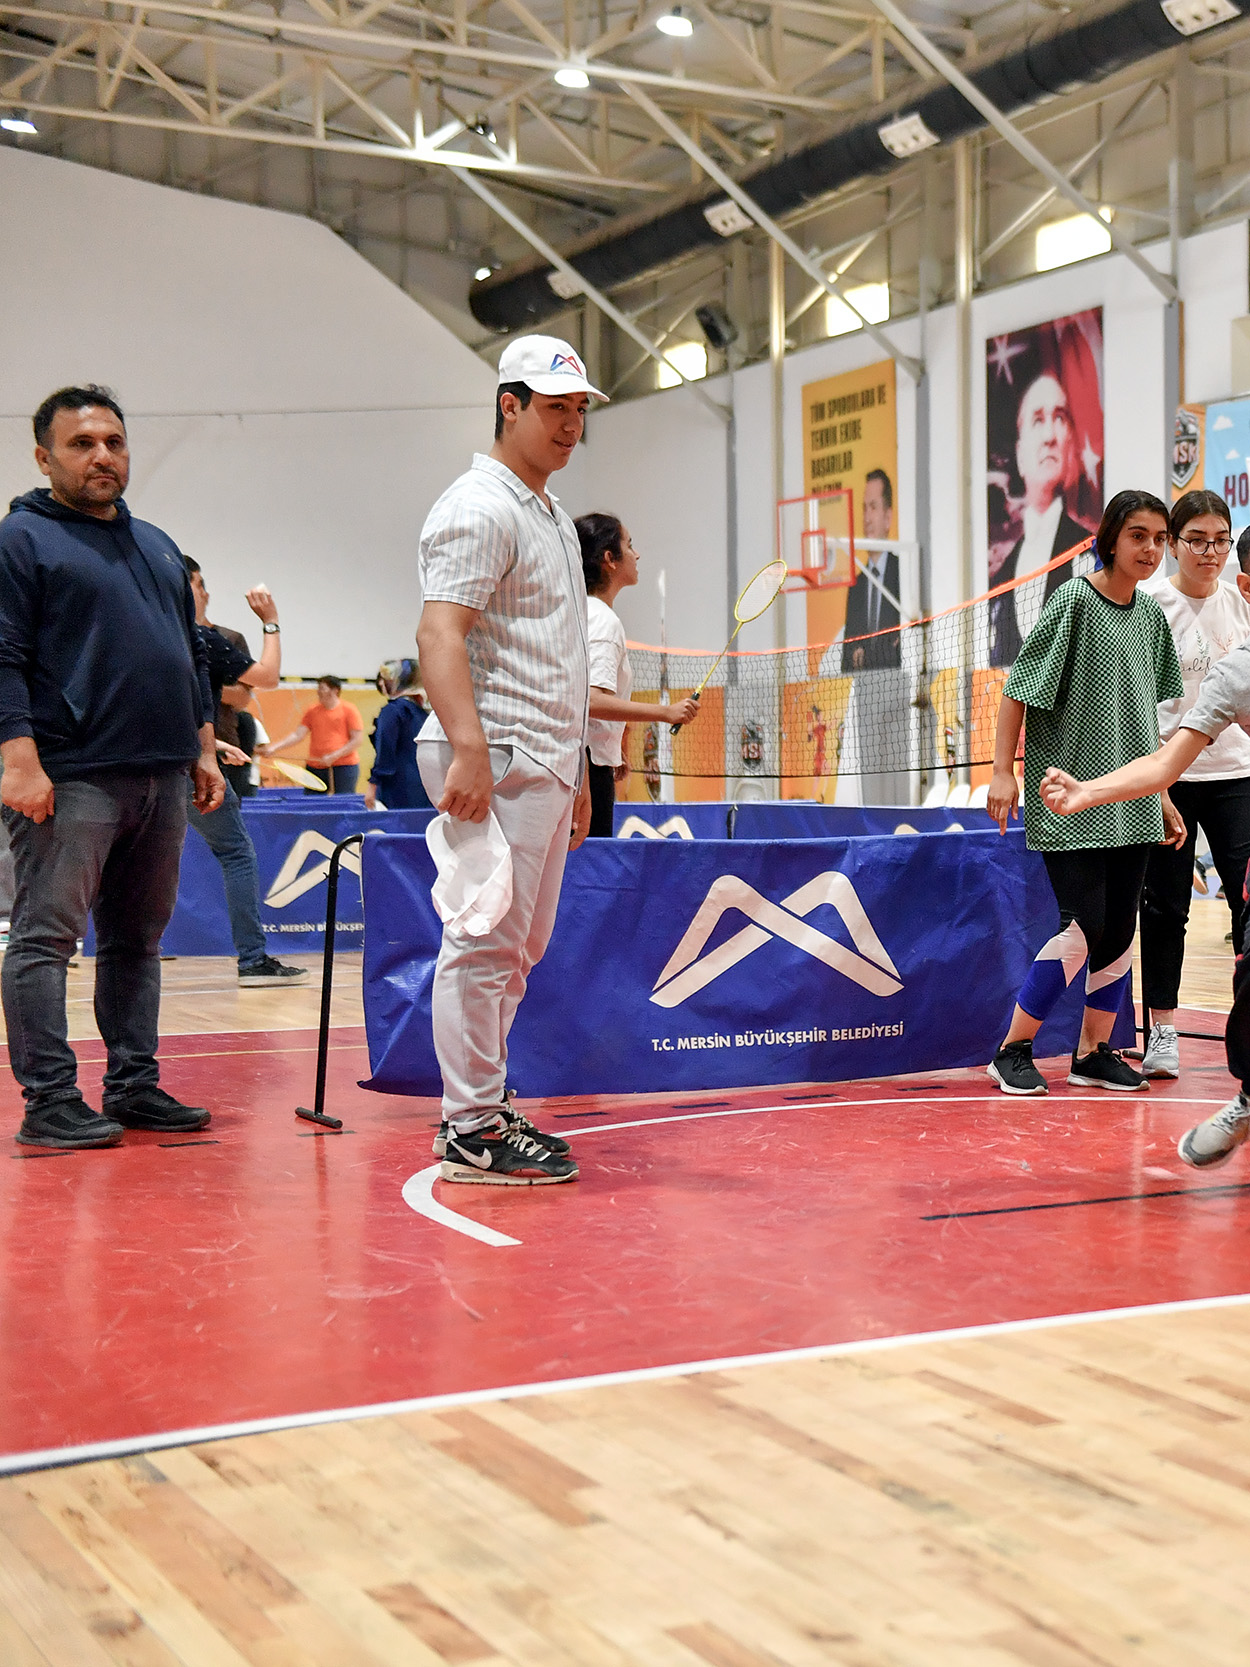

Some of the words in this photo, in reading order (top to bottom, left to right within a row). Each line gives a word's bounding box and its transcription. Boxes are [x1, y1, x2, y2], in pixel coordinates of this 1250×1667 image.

[1224, 472, 1250, 508] HO
[262, 923, 278, 933] T.C.
[279, 921, 316, 933] MERSİN
[651, 1038, 675, 1052] T.C.
[677, 1032, 731, 1050] MERSİN
[735, 1027, 827, 1047] BÜYÜKŞEHİR
[831, 1021, 904, 1041] BELEDİYESİ
